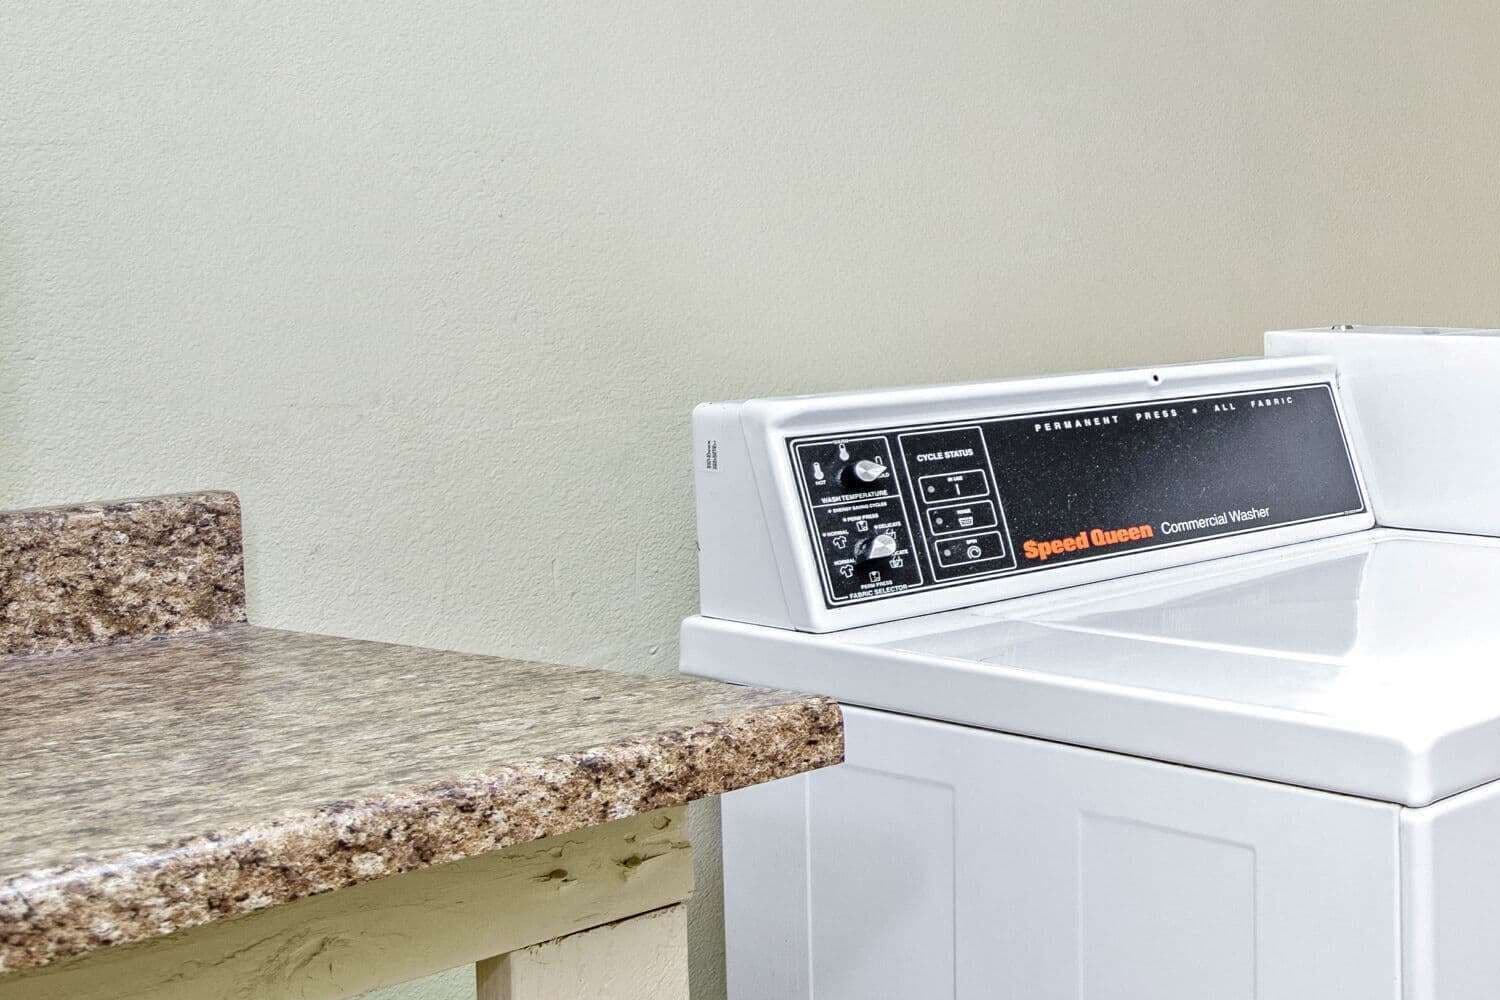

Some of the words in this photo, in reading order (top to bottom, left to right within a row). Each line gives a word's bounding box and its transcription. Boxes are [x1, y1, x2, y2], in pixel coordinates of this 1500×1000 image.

[1034, 415, 1119, 432] PERMANENT
[1135, 409, 1177, 421] PRESS
[1214, 402, 1236, 412] ALL
[1250, 396, 1293, 408] FABRIC
[917, 452, 944, 461] CYCLE
[944, 448, 974, 459] STATUS
[821, 495, 841, 503] WASH
[841, 489, 888, 501] TEMPERATURE
[1023, 531, 1091, 560] Speed
[1090, 523, 1154, 547] Queen
[1160, 511, 1228, 535] Commercial
[1228, 506, 1271, 524] Washer
[834, 558, 856, 566] NORMAL
[849, 590, 873, 600] FABRIC
[874, 583, 908, 595] SELECTOR
